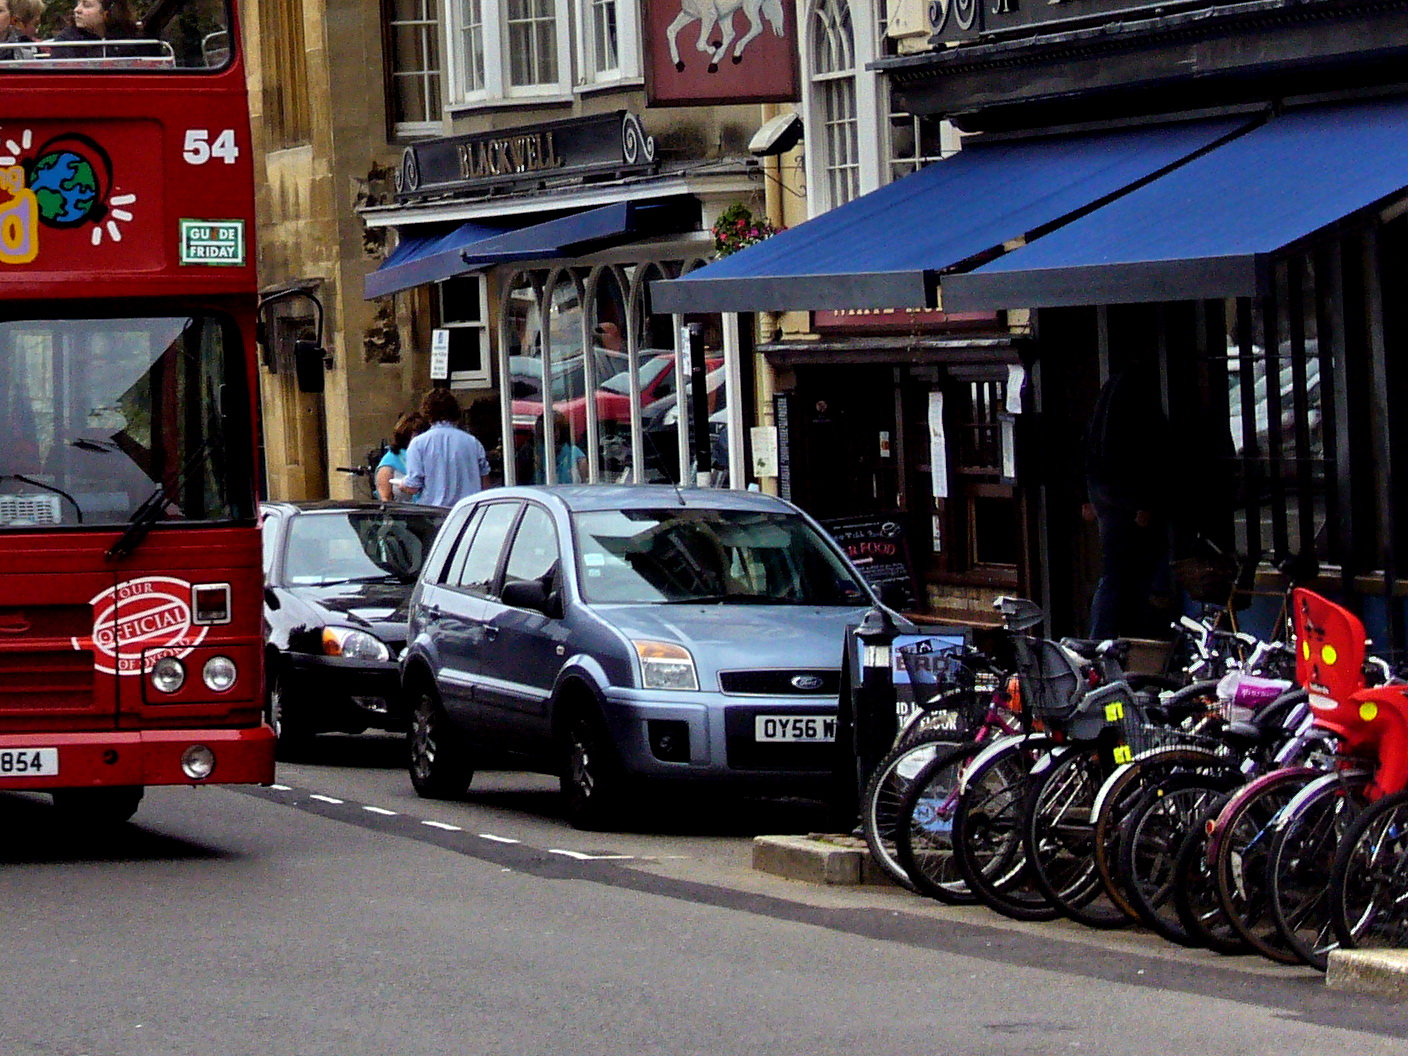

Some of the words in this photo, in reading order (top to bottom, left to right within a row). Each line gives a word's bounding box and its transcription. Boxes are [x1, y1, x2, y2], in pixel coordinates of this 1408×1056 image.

[183, 129, 239, 164] 54
[456, 132, 562, 180] BLACKWELL
[190, 246, 235, 258] FRIDAY
[108, 582, 154, 600] TOUR
[98, 608, 187, 644] OFFICIAL
[118, 658, 137, 671] OF
[764, 718, 817, 739] OY56
